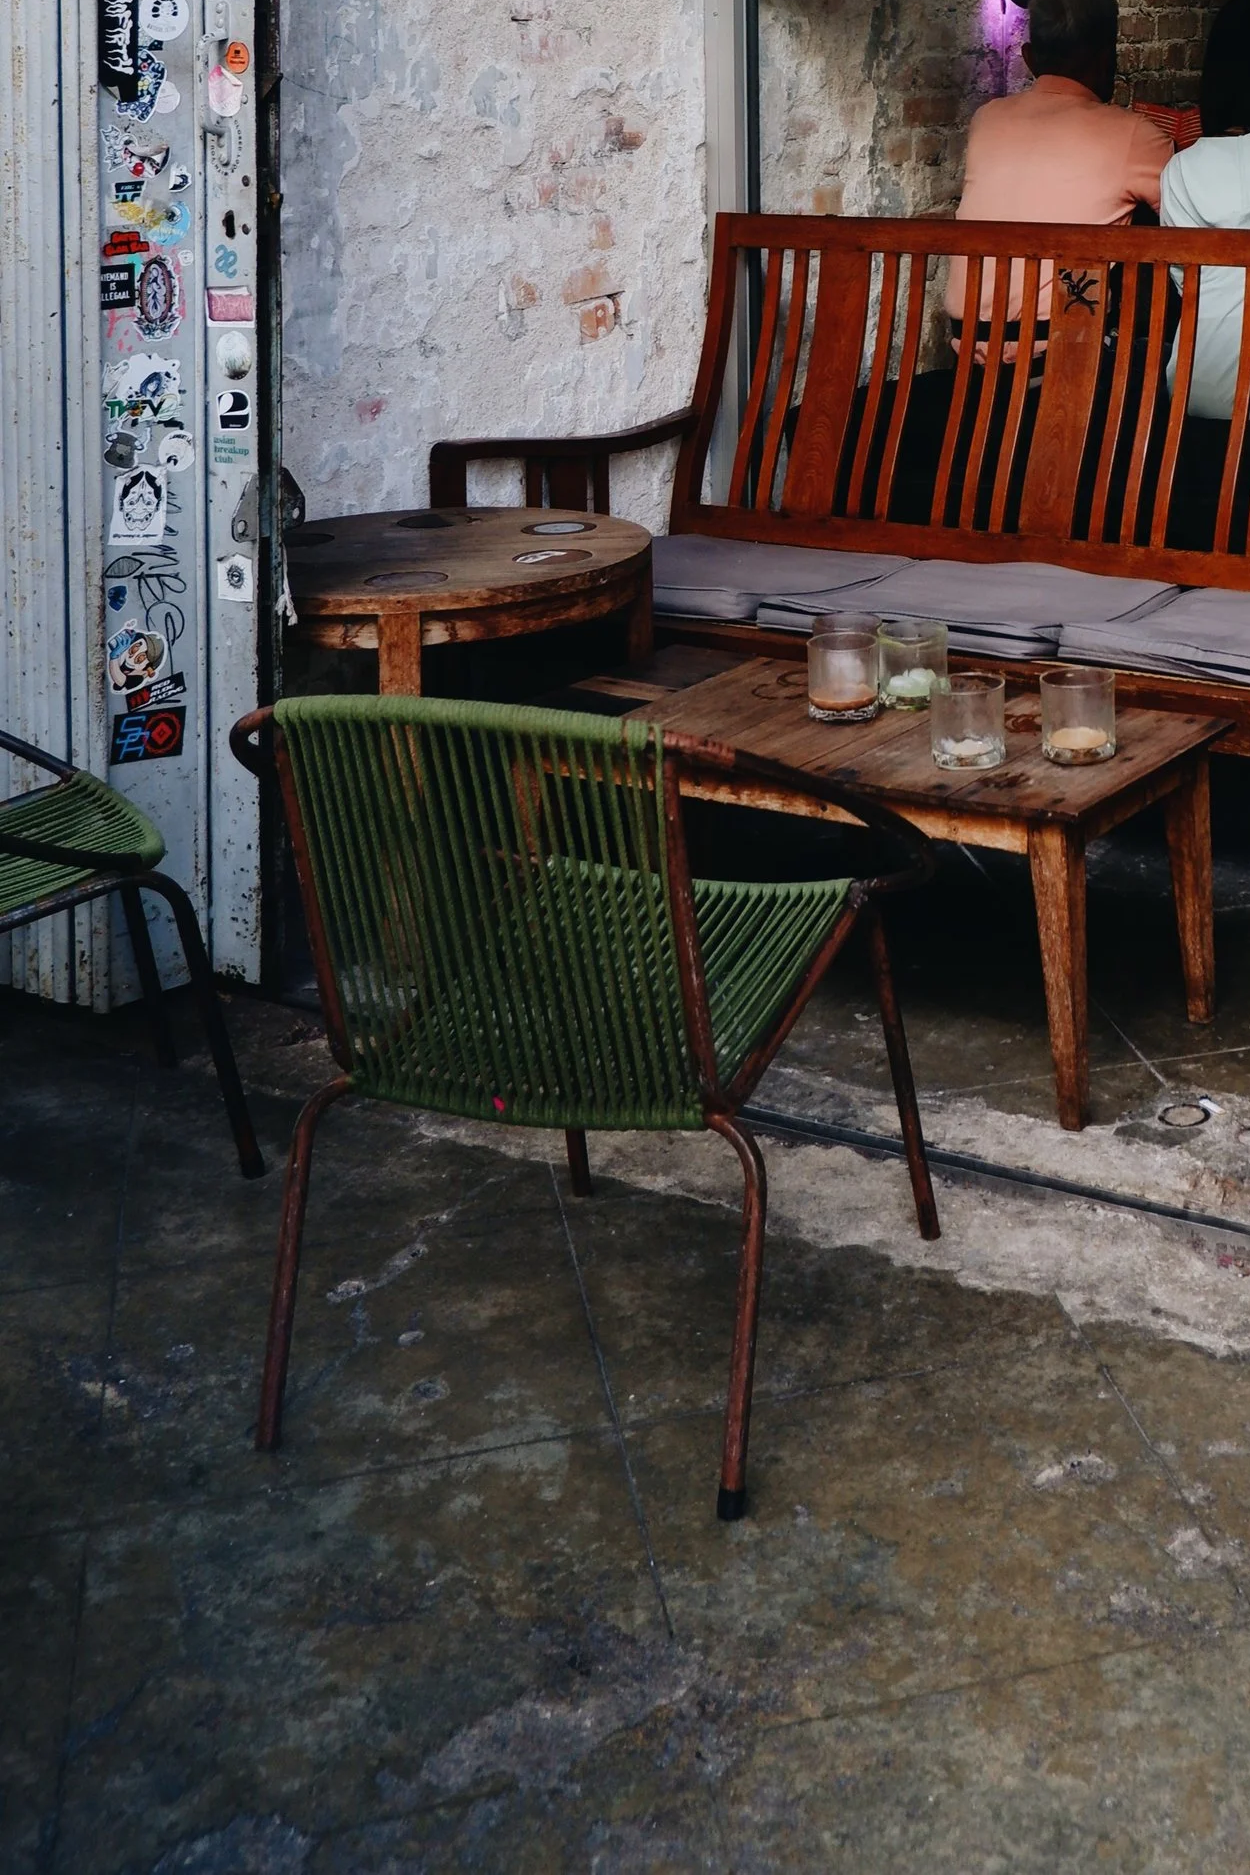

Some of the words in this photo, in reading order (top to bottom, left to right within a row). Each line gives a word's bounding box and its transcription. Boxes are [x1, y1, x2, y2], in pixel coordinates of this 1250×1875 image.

[110, 282, 116, 290] IS
[213, 435, 236, 445] asian
[214, 445, 250, 456] breakup
[214, 455, 233, 464] club
